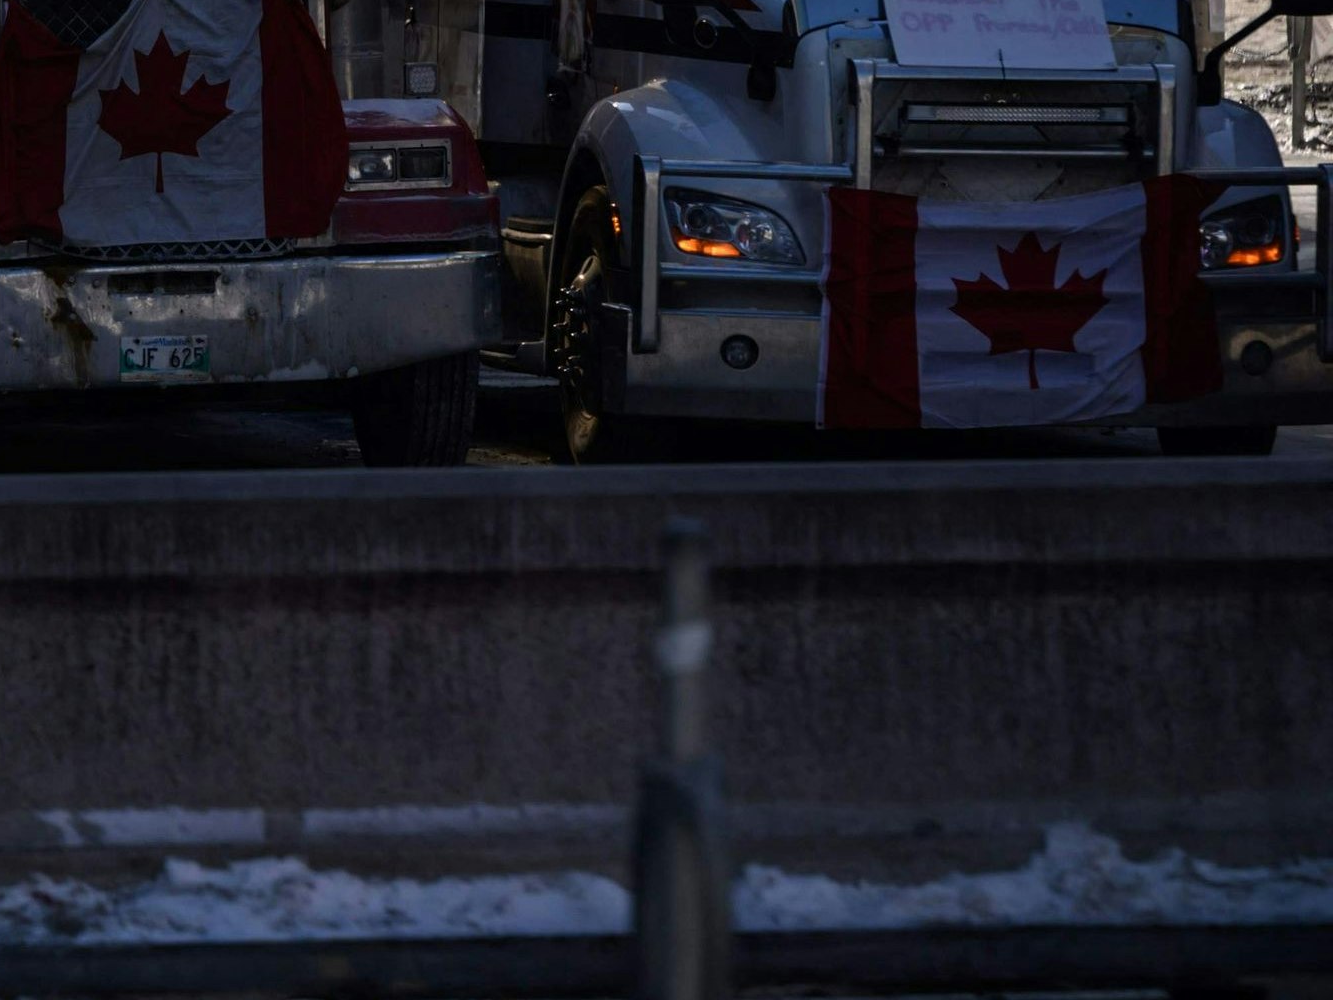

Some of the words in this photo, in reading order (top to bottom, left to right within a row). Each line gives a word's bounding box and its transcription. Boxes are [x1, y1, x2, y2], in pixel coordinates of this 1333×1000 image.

[901, 11, 953, 33] OPP
[124, 347, 158, 369] CJF
[171, 346, 205, 369] 625
